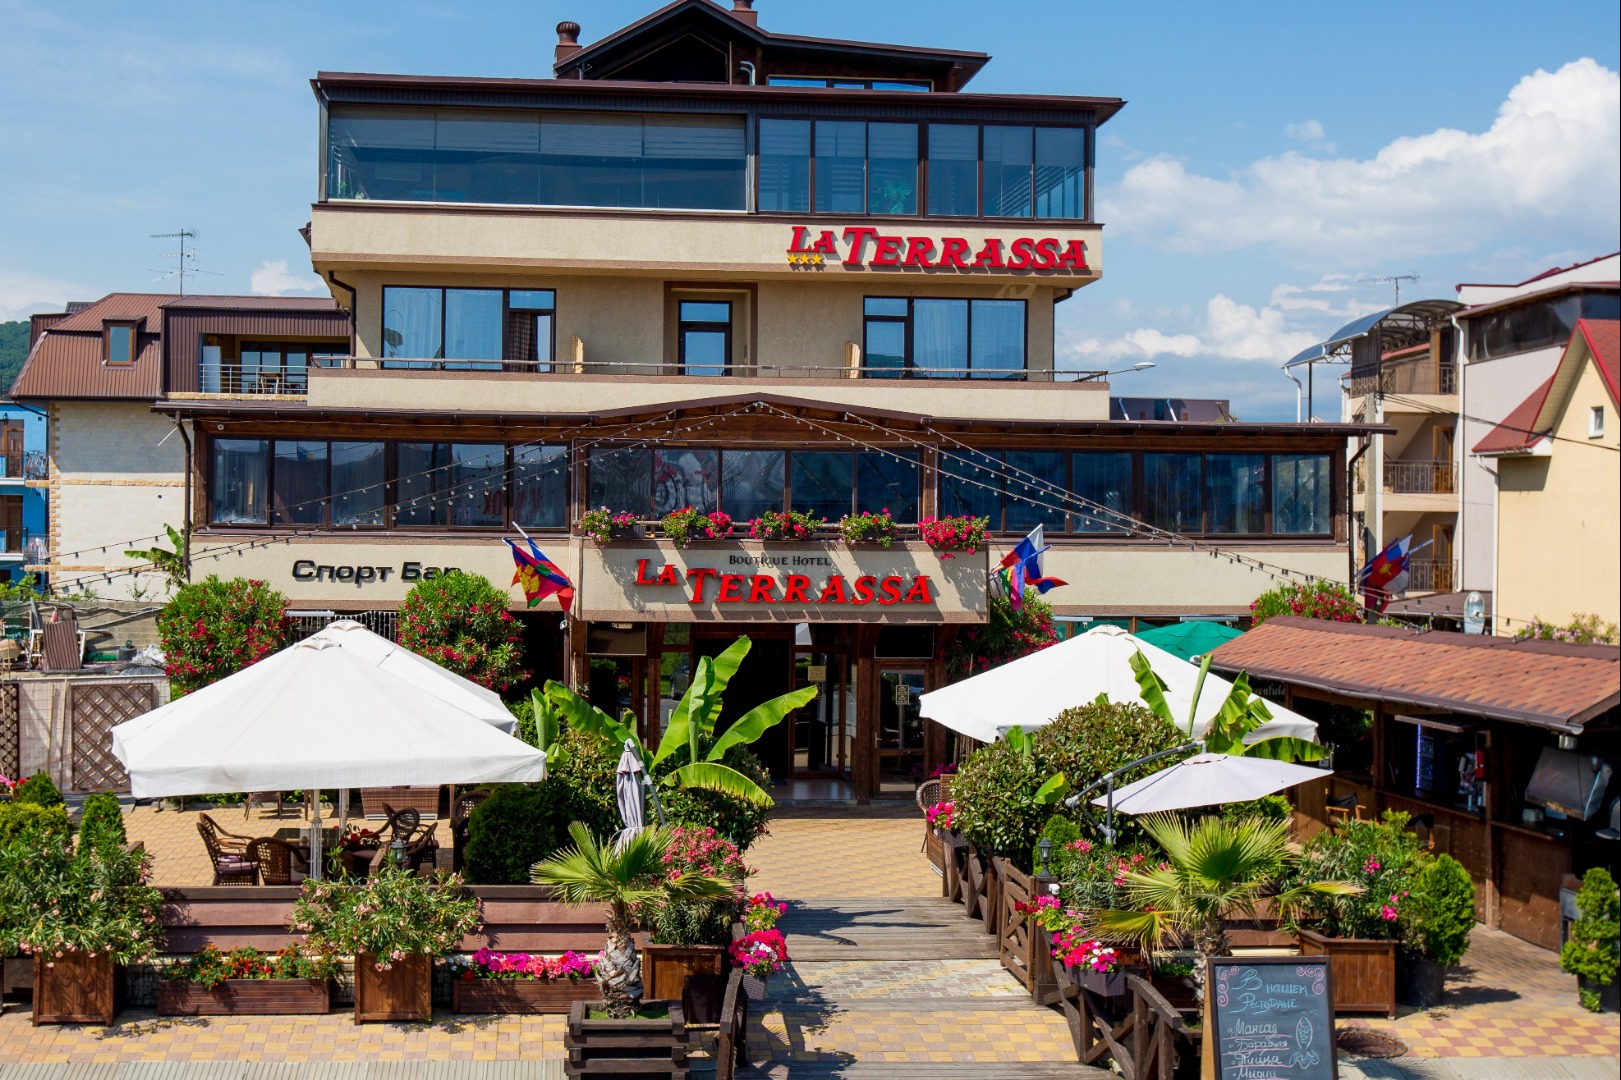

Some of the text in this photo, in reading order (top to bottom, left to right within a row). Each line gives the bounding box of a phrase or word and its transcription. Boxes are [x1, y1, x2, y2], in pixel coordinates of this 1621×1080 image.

[786, 226, 1089, 270] LA TERRASSA
[292, 560, 393, 585] Спорт
[792, 555, 832, 566] HOTEL
[634, 559, 934, 606] LA TERRASSA
[1232, 968, 1263, 991] В
